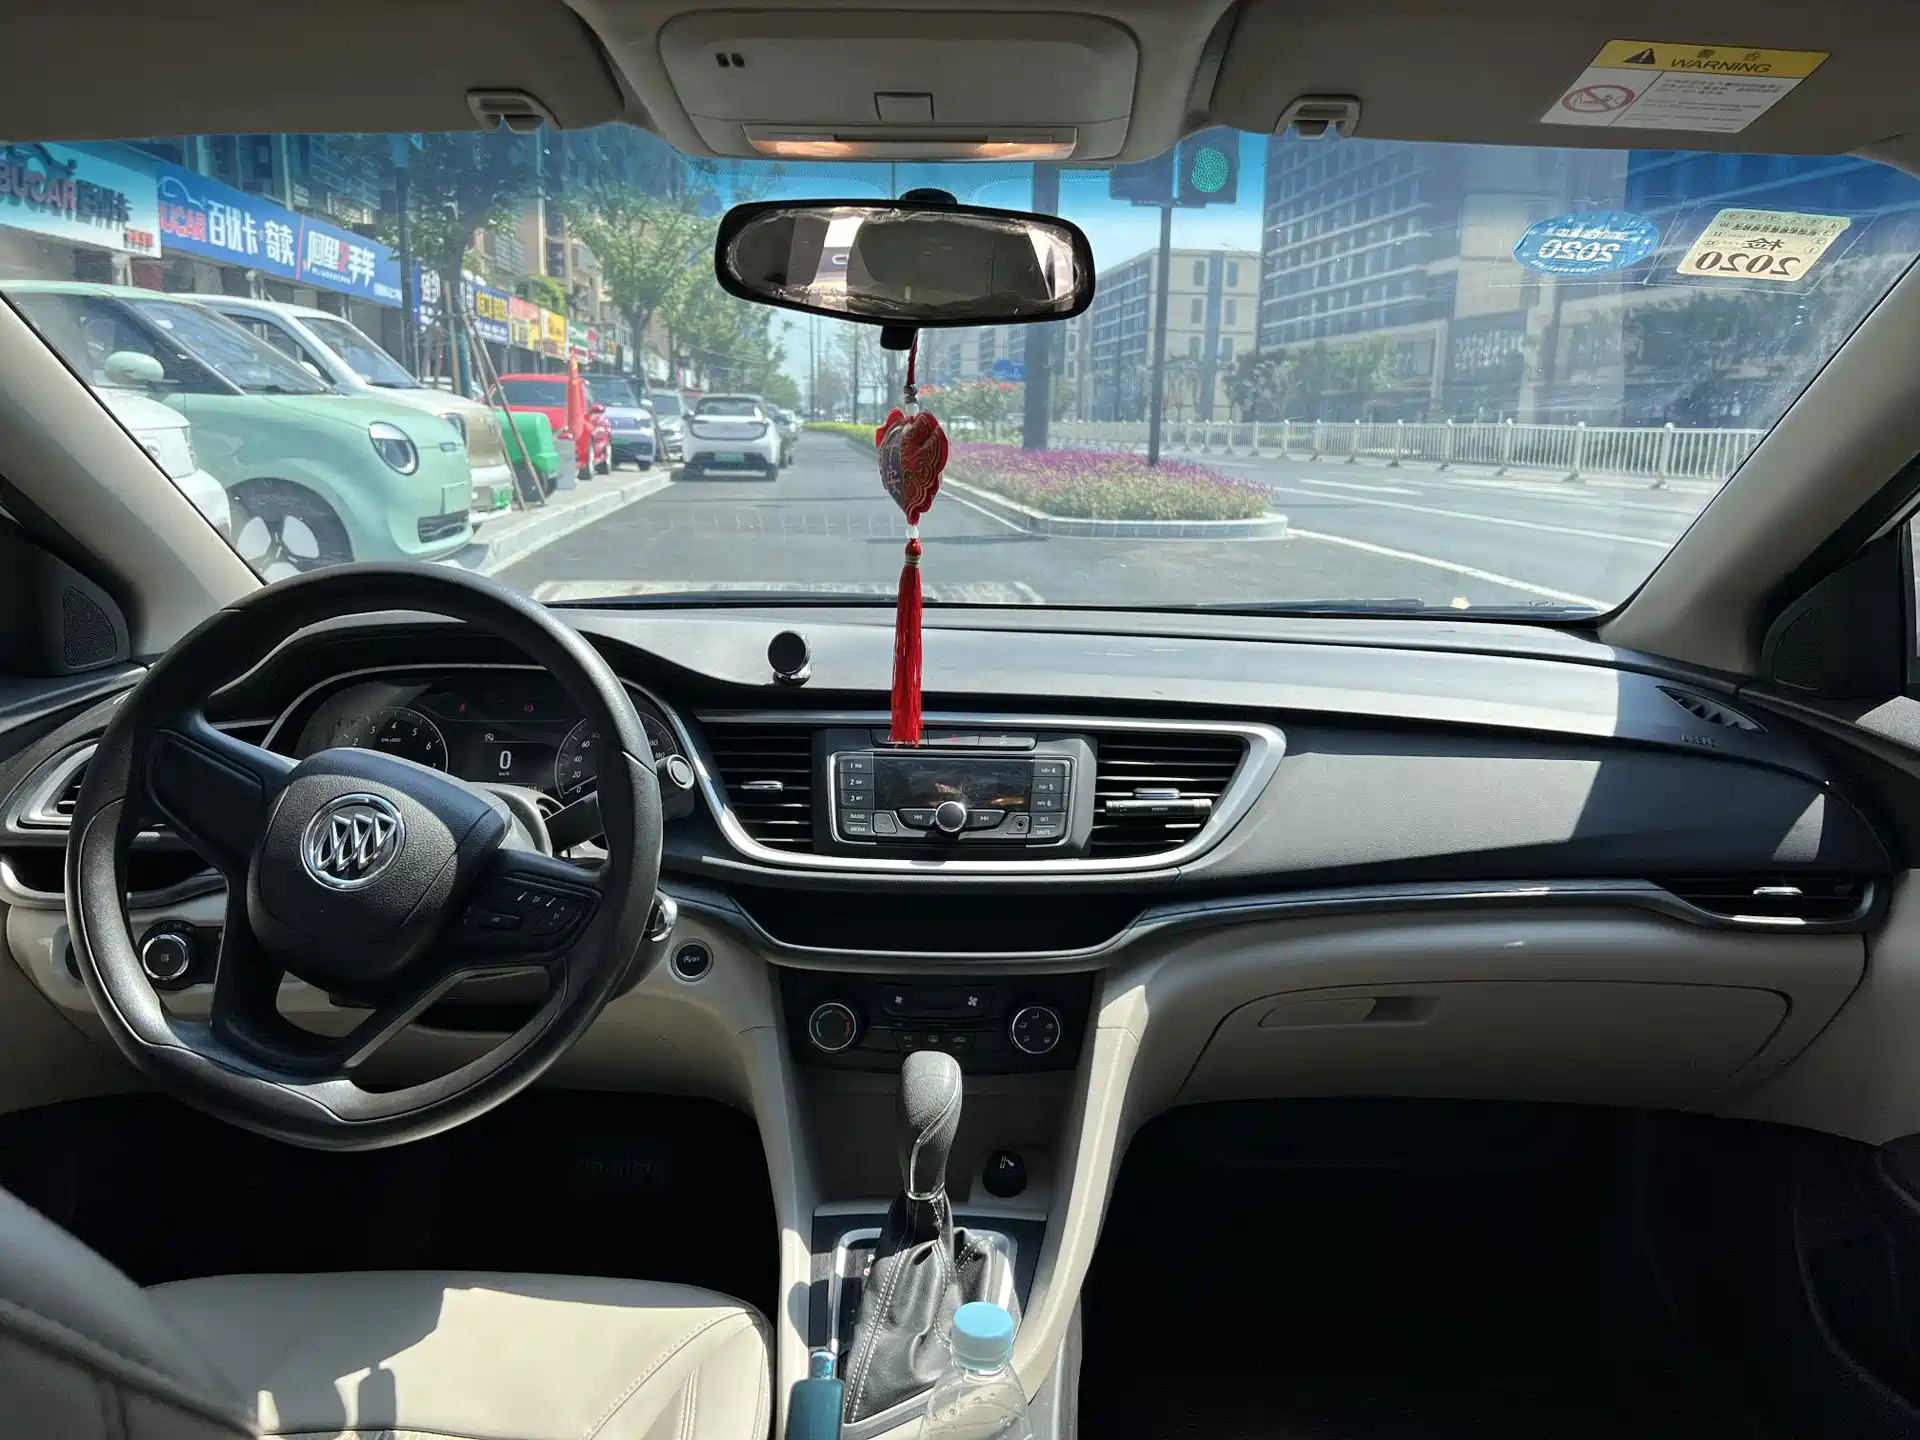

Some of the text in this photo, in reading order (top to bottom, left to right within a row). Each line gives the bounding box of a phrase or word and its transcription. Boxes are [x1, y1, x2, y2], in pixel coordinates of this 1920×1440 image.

[1670, 58, 1772, 73] WARNING
[0, 158, 77, 212] BUCAR
[160, 202, 206, 243] UCAR
[370, 726, 376, 734] 3
[391, 722, 397, 730] 4
[412, 728, 417, 736] 5
[353, 738, 359, 746] 2
[426, 742, 432, 750] 6
[500, 750, 511, 769] 0
[868, 1253, 875, 1262] P
